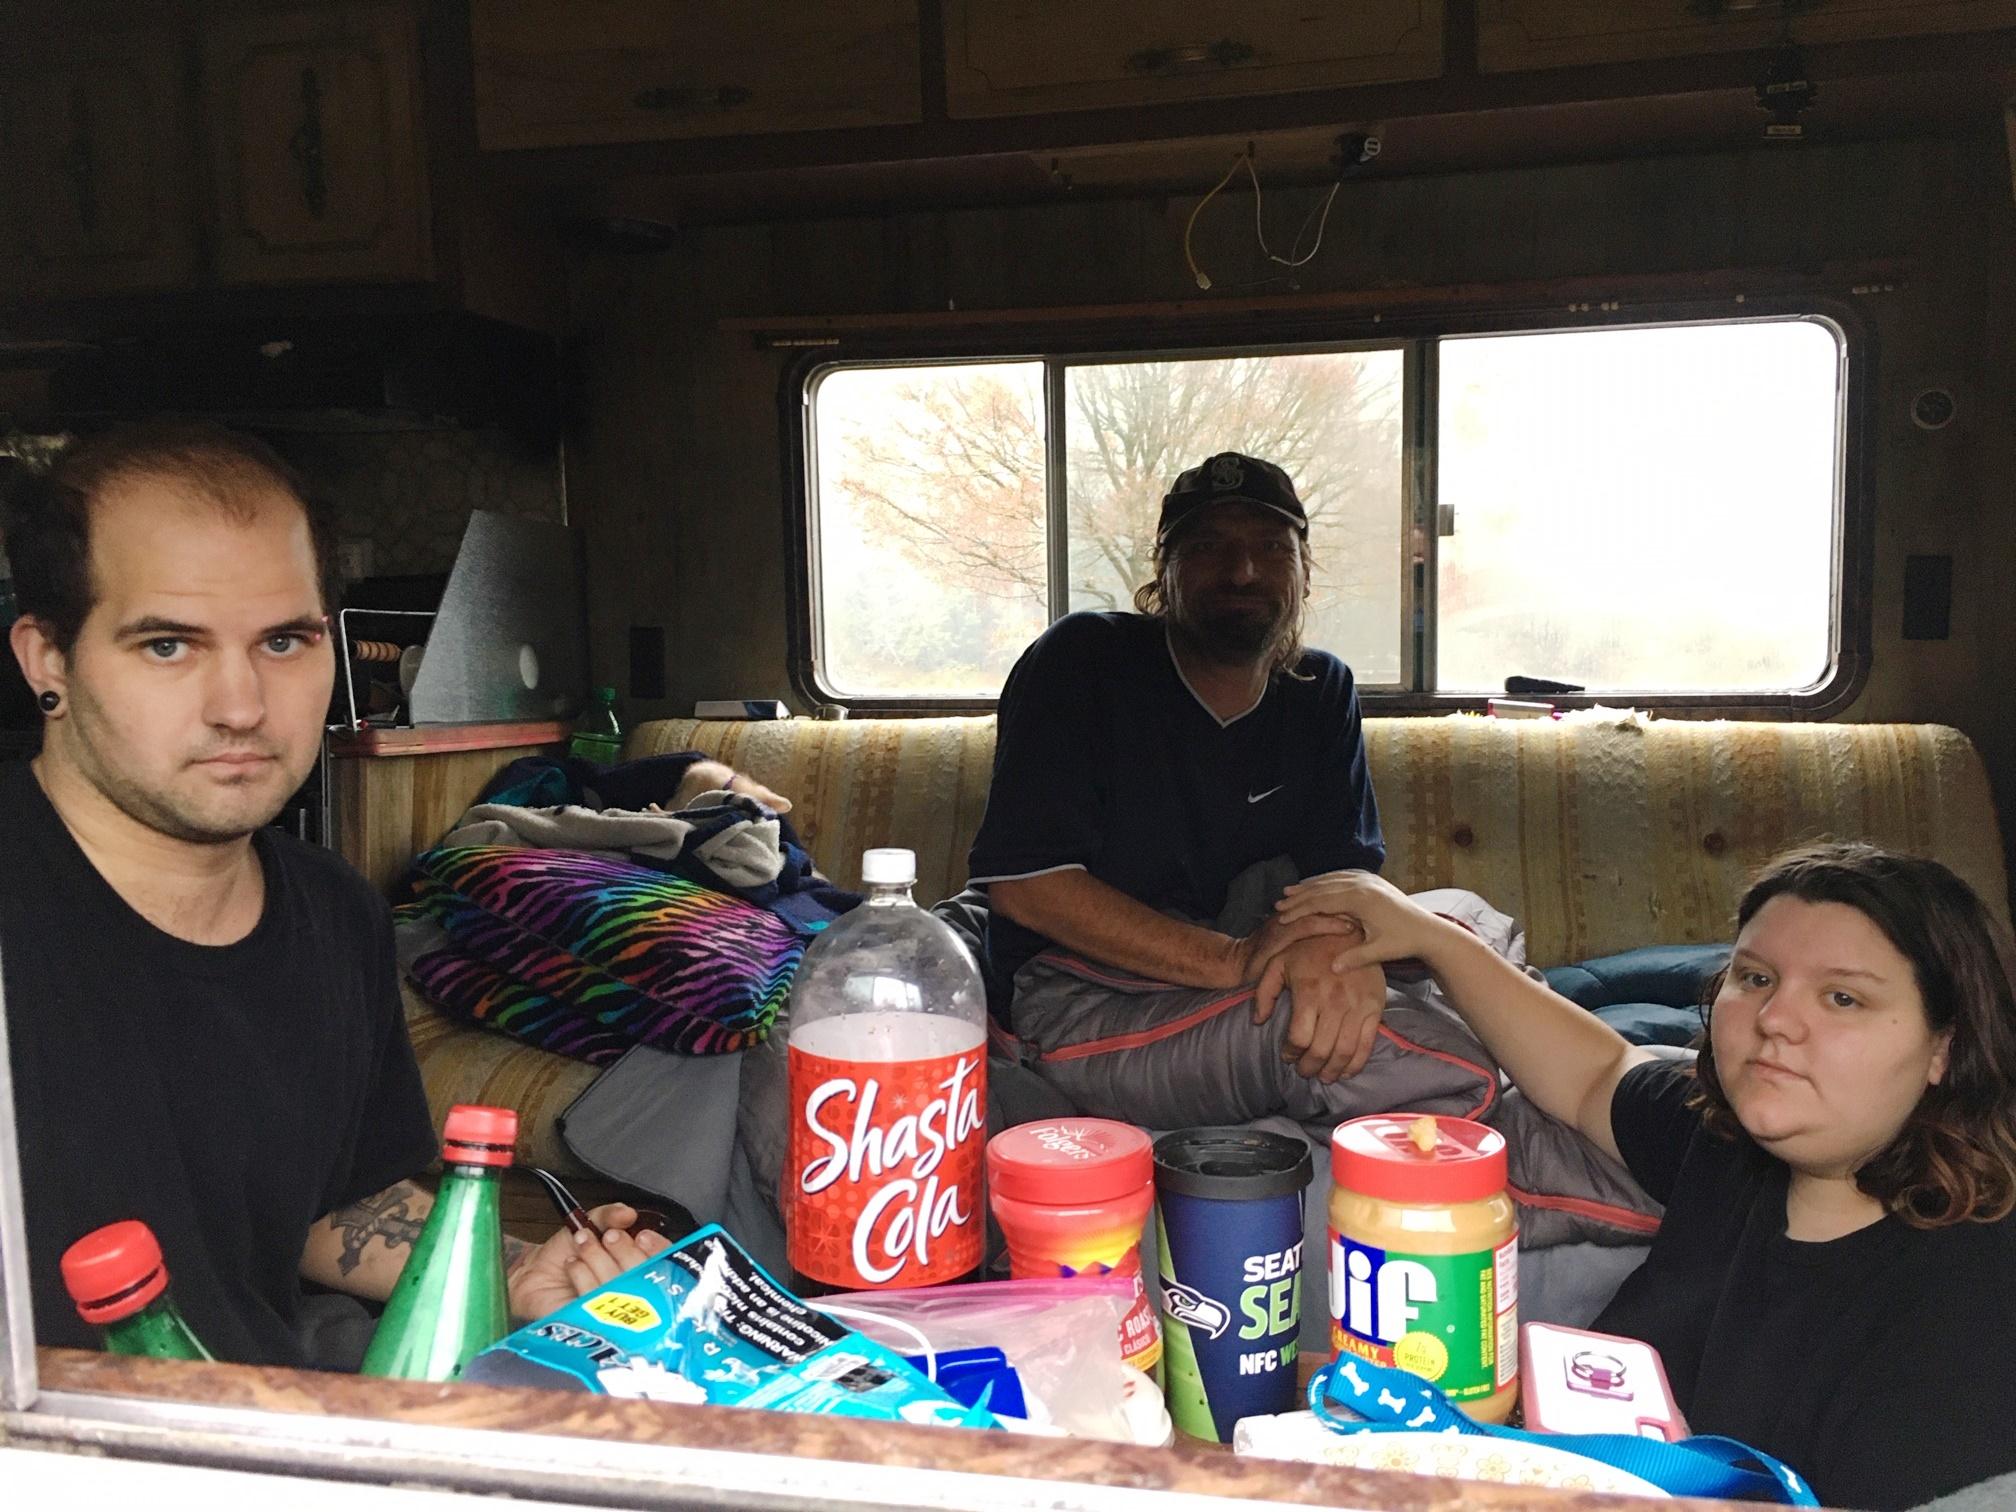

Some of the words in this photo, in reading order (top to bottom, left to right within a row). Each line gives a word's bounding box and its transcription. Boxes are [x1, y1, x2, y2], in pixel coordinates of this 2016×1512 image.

[801, 1057, 984, 1194] Shasta
[1028, 1126, 1097, 1160] Folgers
[852, 1175, 970, 1283] Cola
[748, 1271, 808, 1316] chemical.
[749, 1293, 768, 1308] an
[1328, 1238, 1438, 1343] Jif
[605, 1309, 638, 1325] BUY
[619, 1302, 650, 1318] GET
[765, 1306, 781, 1317] is
[736, 1322, 806, 1362] WARNING:
[747, 1311, 806, 1346] contains
[780, 1314, 834, 1347] Nicotine
[1332, 1326, 1380, 1360] CREAMY
[1240, 1350, 1278, 1375] NFC
